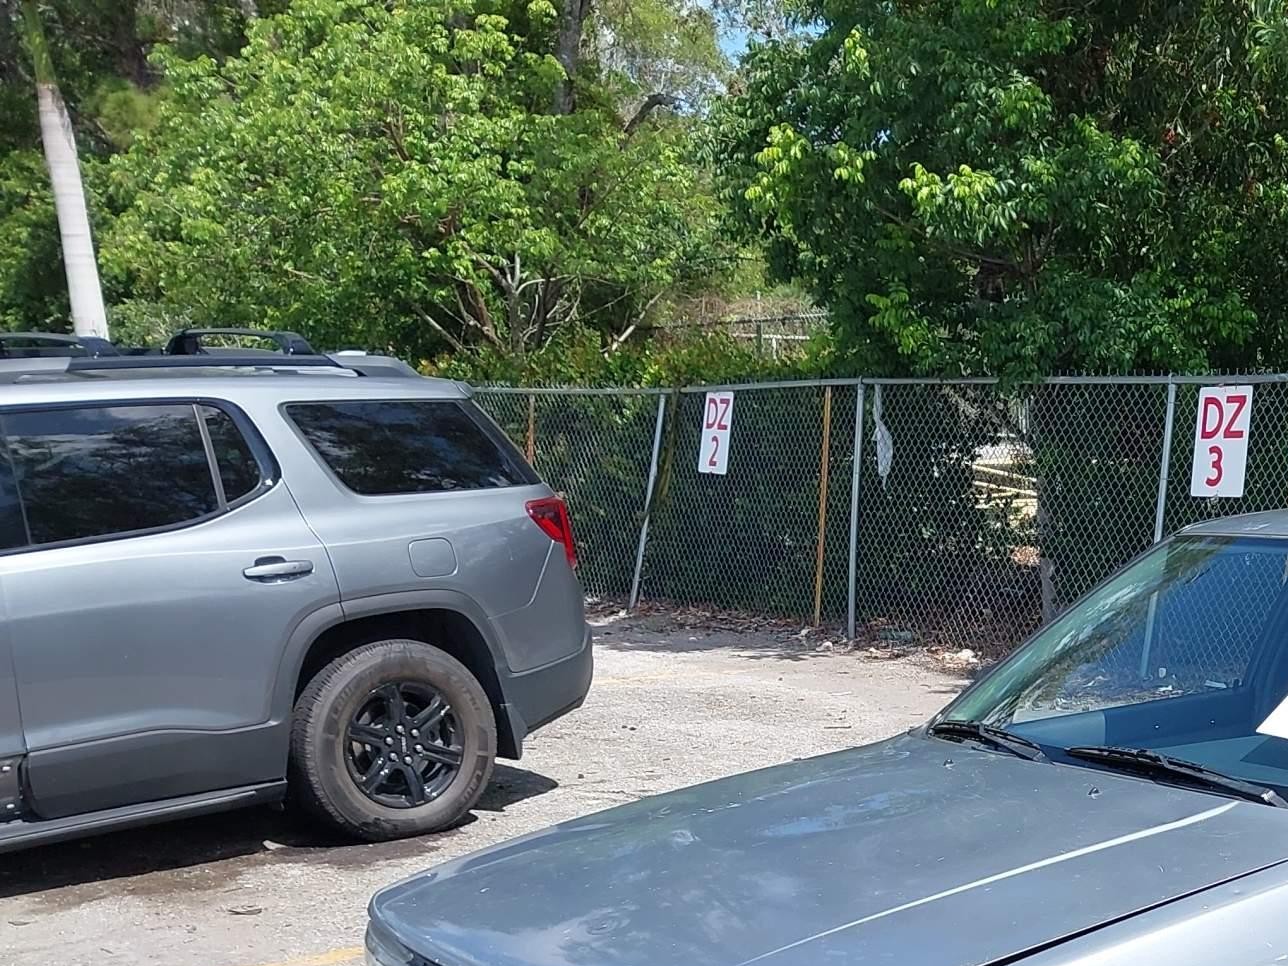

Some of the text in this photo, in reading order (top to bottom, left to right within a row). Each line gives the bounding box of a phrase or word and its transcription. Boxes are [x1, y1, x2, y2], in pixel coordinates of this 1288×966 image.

[706, 398, 731, 430] DZ
[1201, 395, 1247, 439] DZ
[709, 435, 719, 466] 2
[1206, 446, 1223, 486] 3
